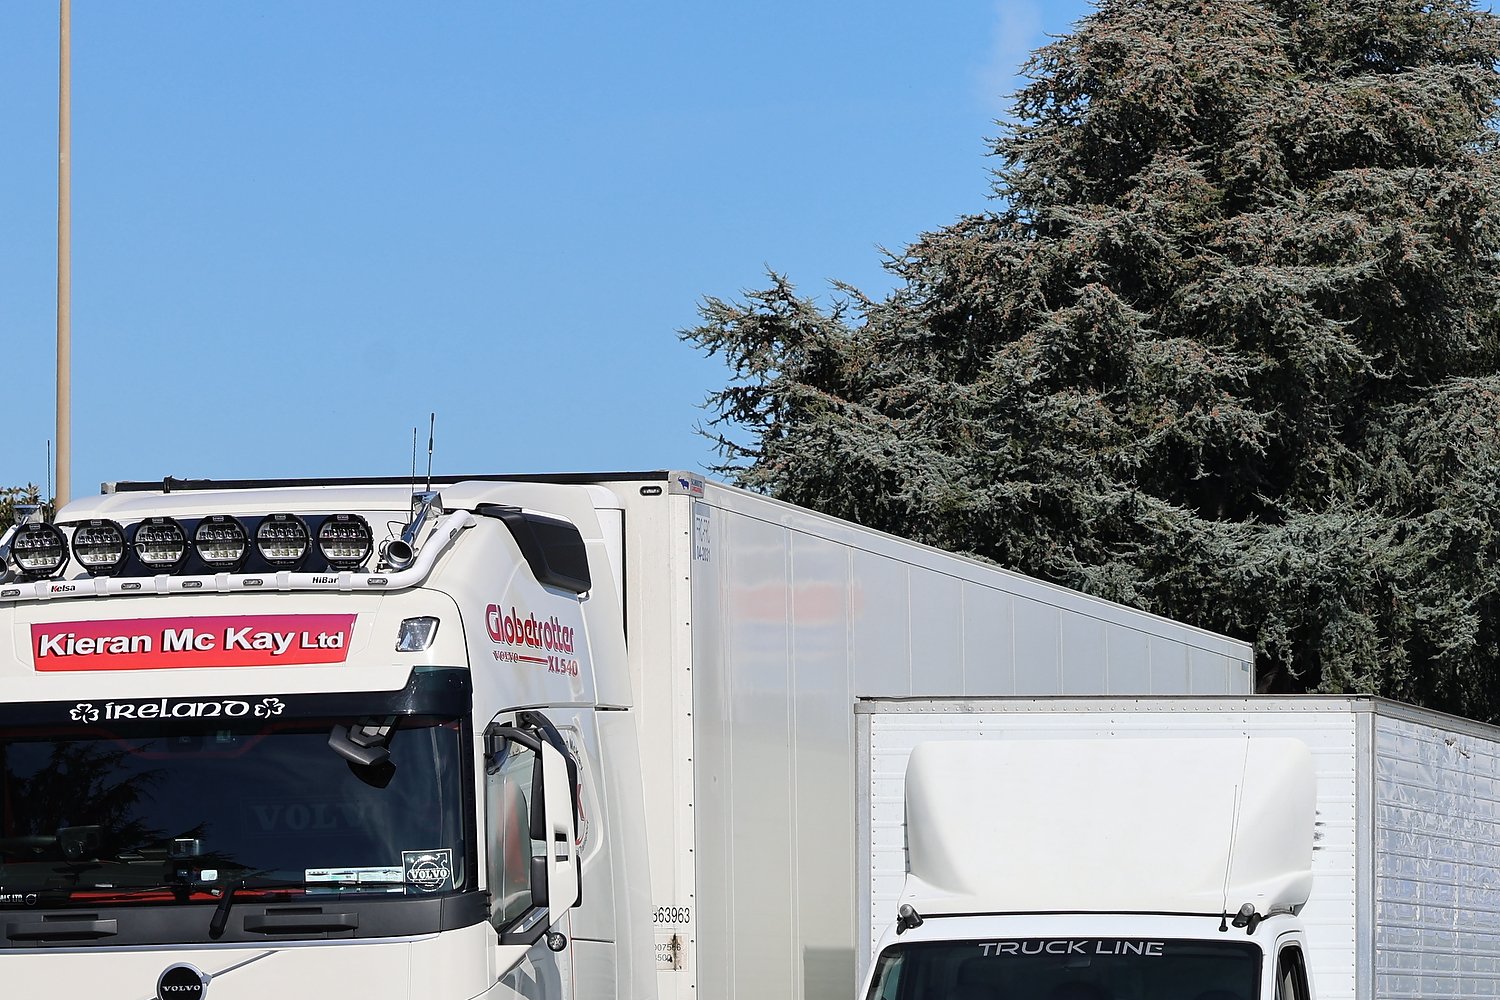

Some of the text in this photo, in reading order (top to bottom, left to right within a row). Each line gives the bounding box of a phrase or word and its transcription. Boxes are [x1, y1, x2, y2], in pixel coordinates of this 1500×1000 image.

[312, 576, 339, 585] HiBar
[51, 583, 76, 593] Kelsa
[485, 603, 575, 655] Globetrotter
[38, 627, 345, 658] Kieran Mc Kay Ltd
[408, 868, 450, 880] VOLVO
[978, 940, 1165, 957] TRUCK LINE
